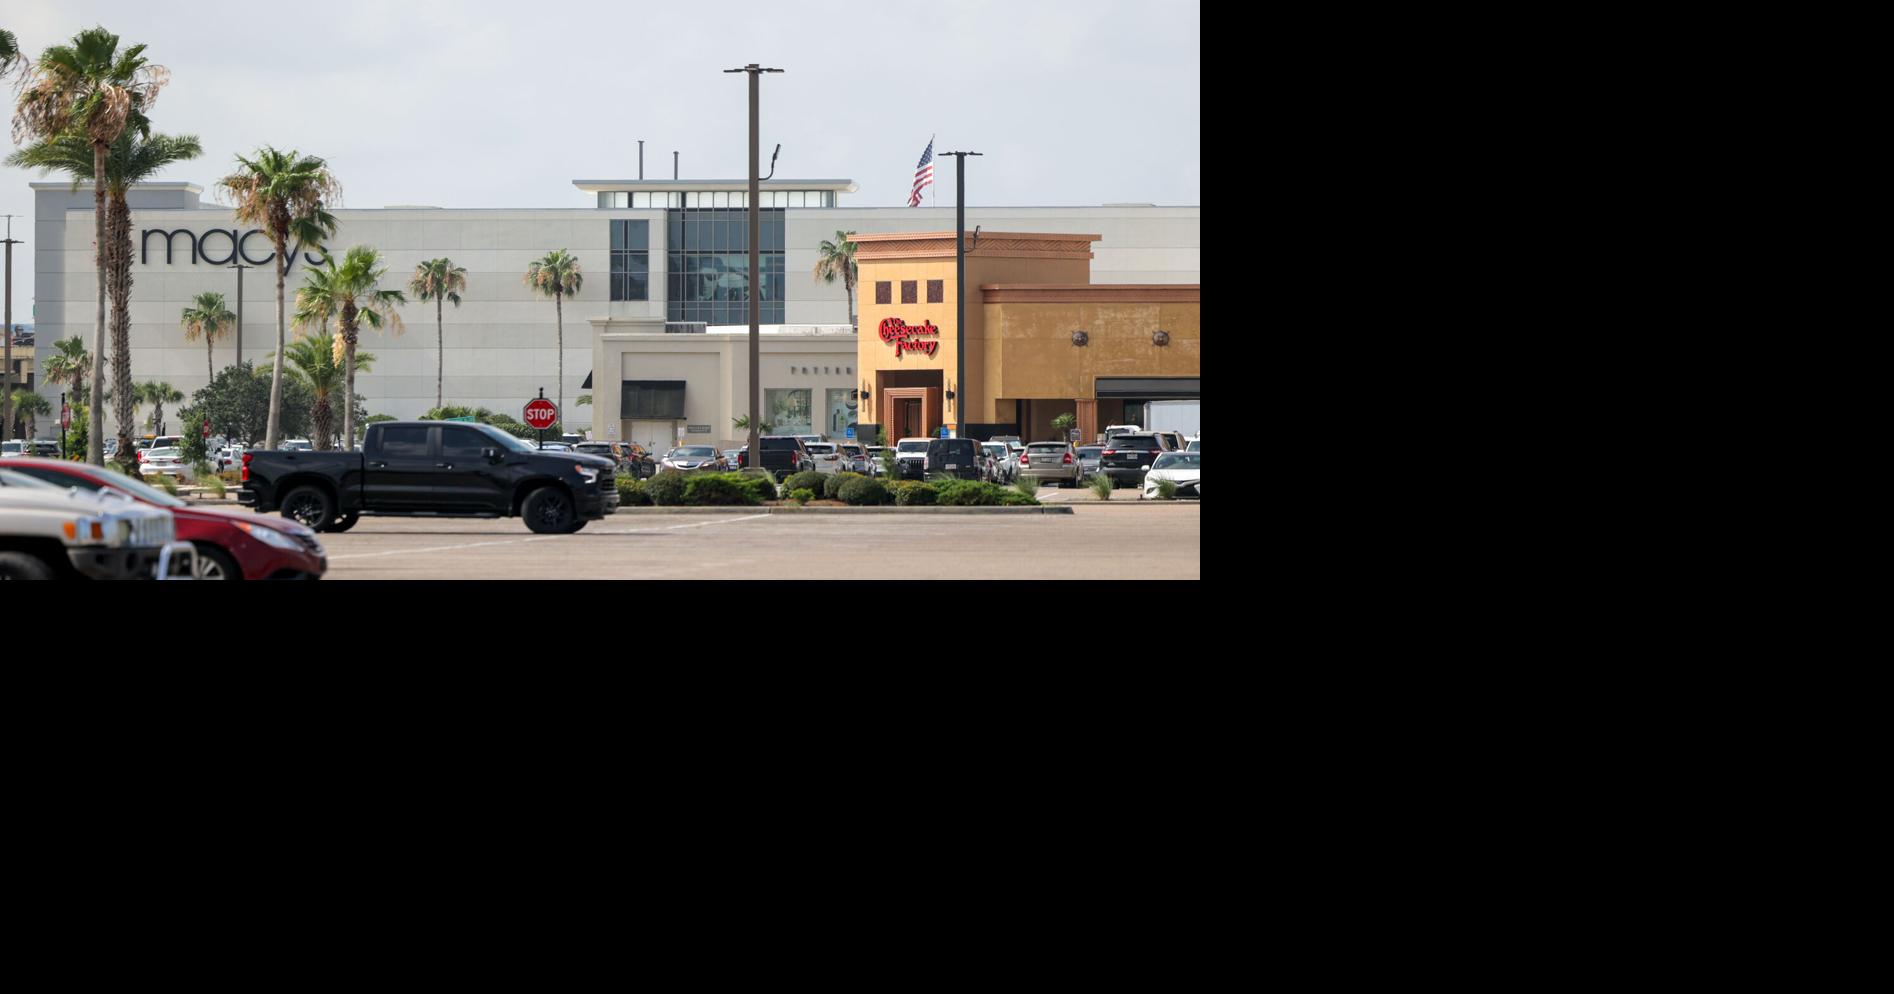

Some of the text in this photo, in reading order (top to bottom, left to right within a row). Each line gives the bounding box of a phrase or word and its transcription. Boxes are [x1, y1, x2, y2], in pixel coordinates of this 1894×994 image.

[879, 318, 938, 343] Cheesecake
[891, 335, 938, 357] Factory
[527, 409, 555, 420] STOP
